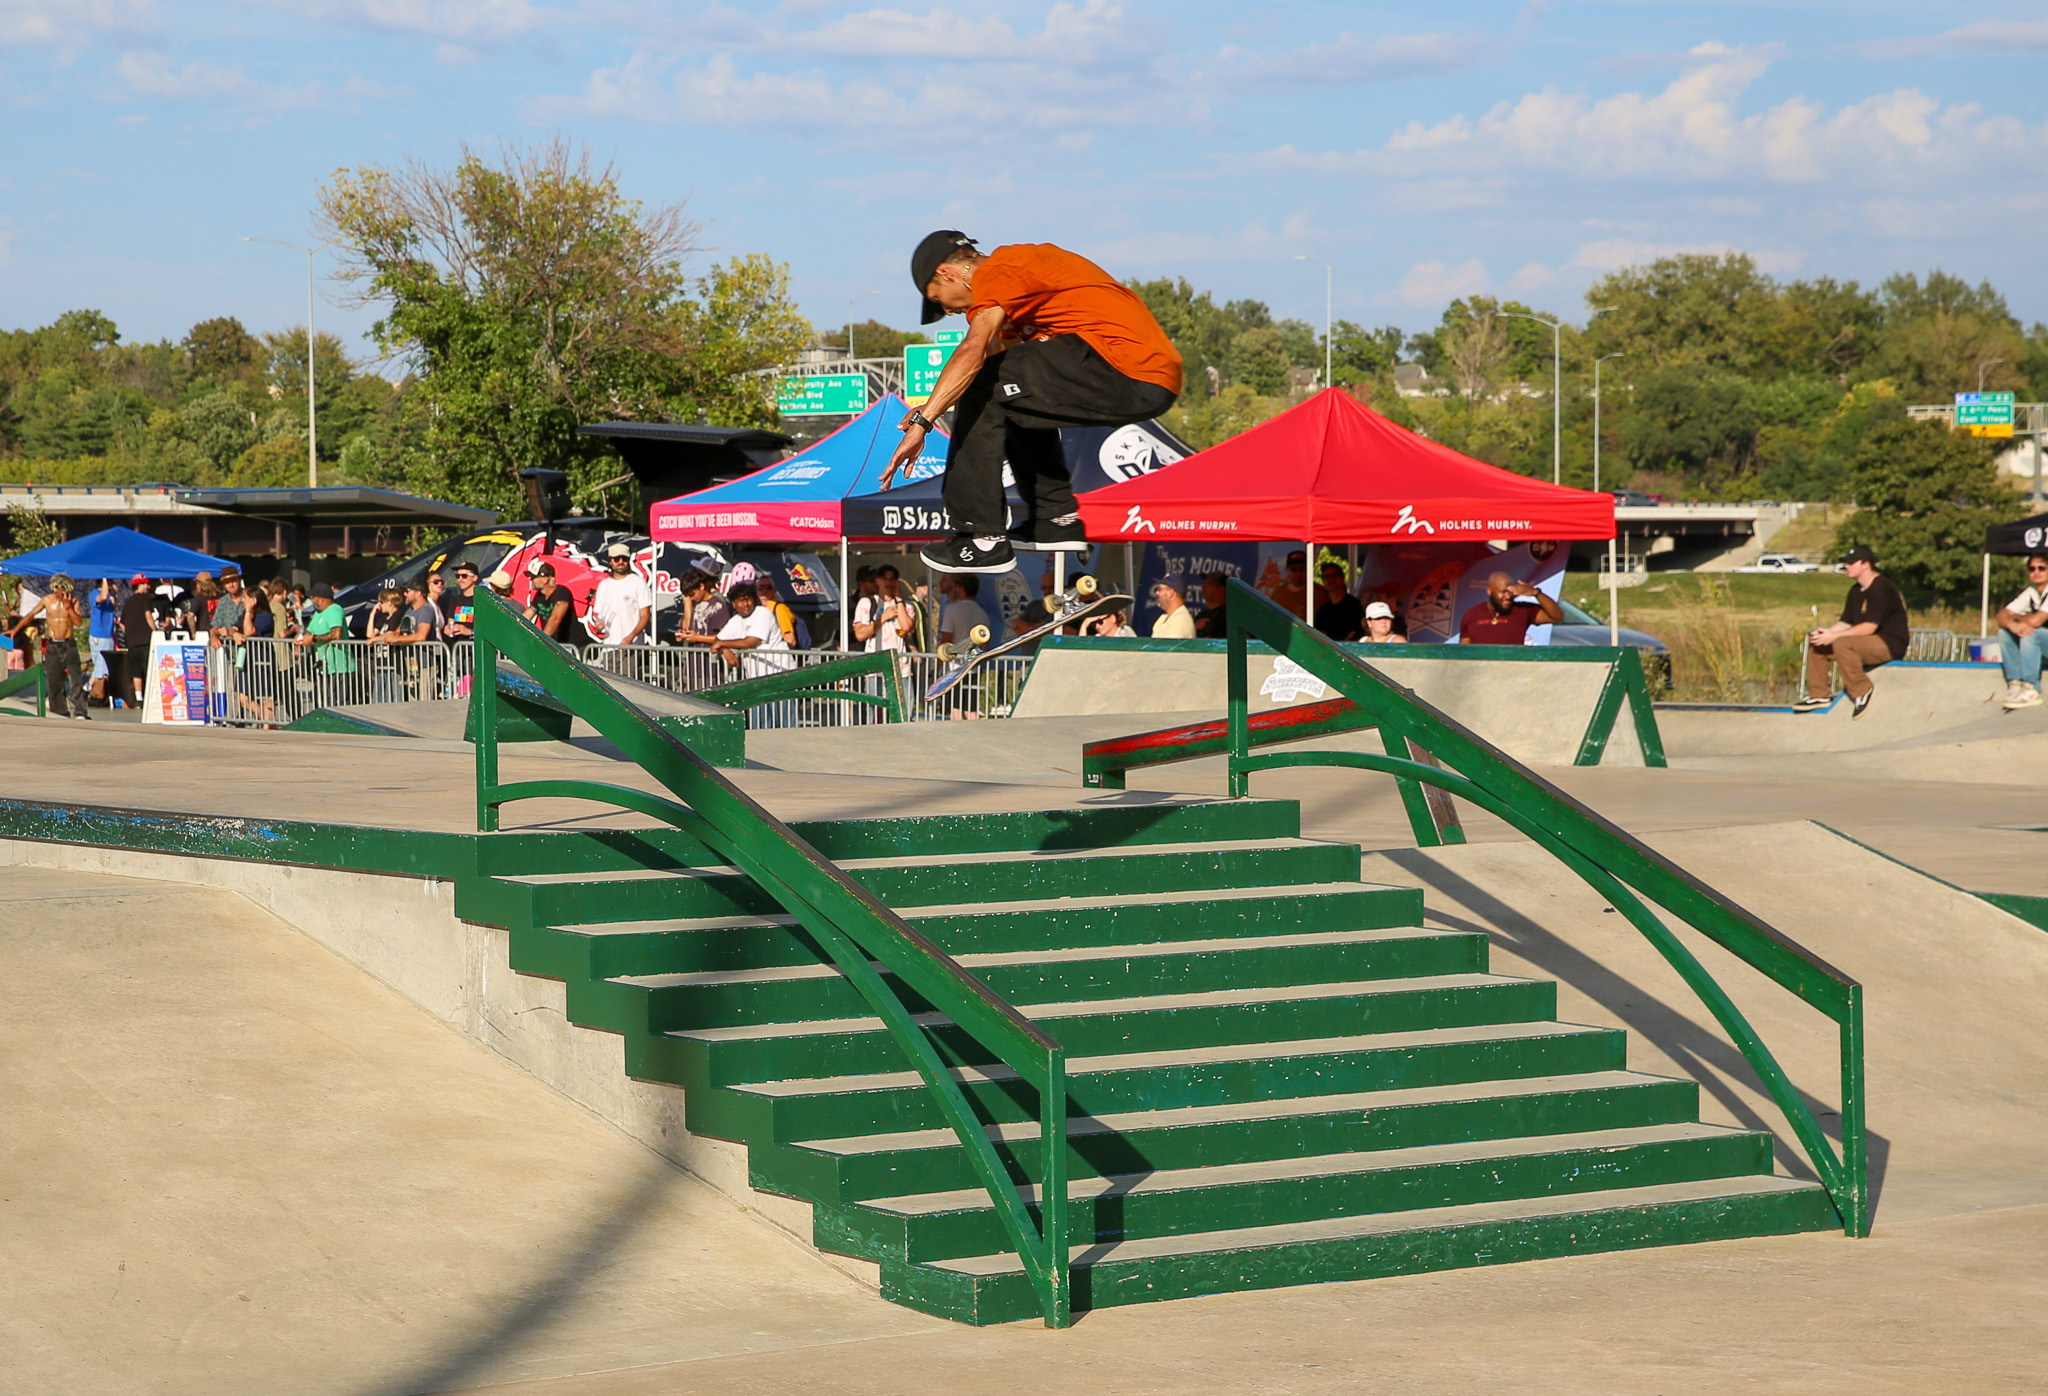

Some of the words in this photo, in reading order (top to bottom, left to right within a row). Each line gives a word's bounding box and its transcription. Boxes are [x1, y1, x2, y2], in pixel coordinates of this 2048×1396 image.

[914, 370, 921, 380] E
[915, 382, 921, 392] E
[858, 389, 863, 398] 2
[810, 401, 824, 409] Ave
[658, 515, 678, 529] CATCH
[678, 514, 695, 528] WHAT
[695, 513, 716, 527] YOU'VE
[716, 512, 732, 526] BEEN
[733, 511, 759, 526] MISSING.
[789, 516, 835, 528] #CATCHdsm
[882, 505, 952, 534] @Skat
[1159, 520, 1196, 530] HOLMES
[1439, 519, 1483, 530] HOLMES
[1165, 556, 1186, 574] DES
[1189, 556, 1242, 577] MOINES
[384, 578, 396, 590] 10
[656, 570, 681, 593] Re
